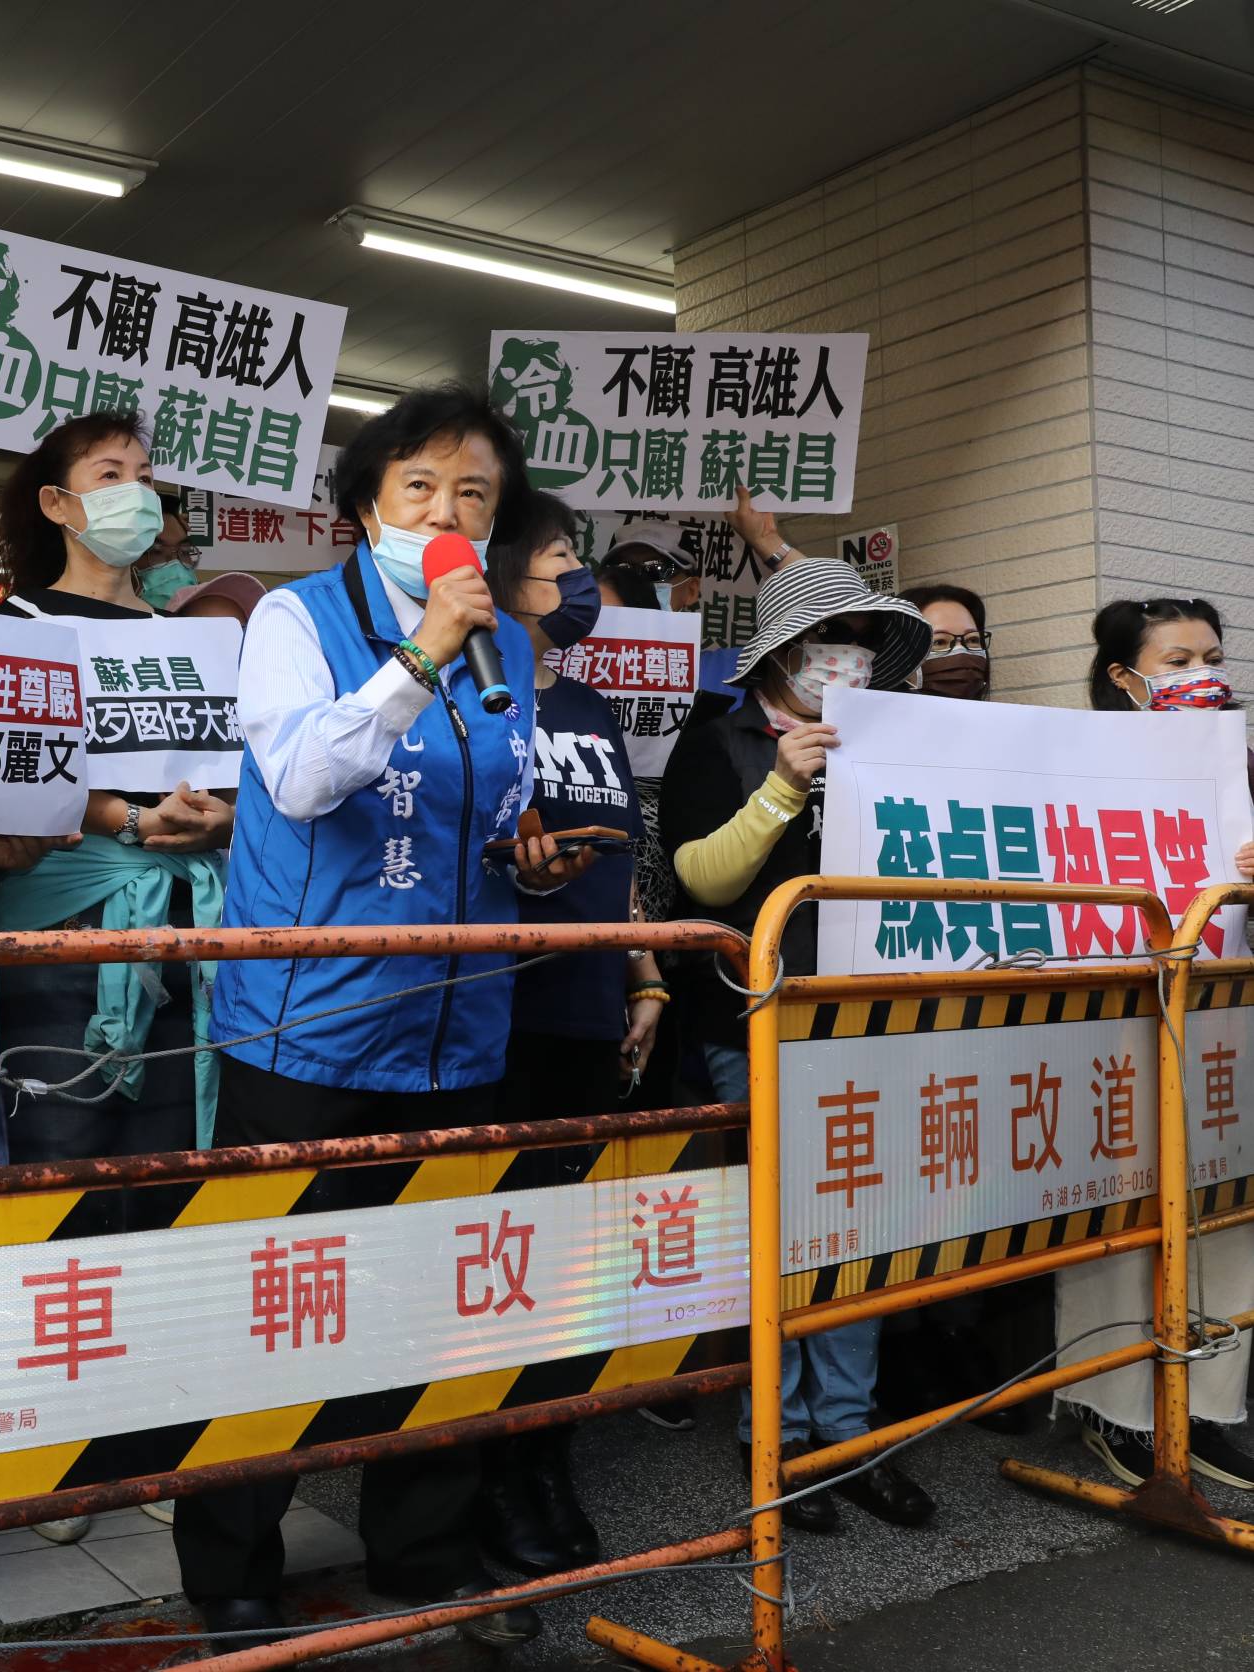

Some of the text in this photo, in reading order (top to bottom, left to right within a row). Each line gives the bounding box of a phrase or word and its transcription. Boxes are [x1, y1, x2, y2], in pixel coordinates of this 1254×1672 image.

[53, 264, 314, 400] 不顧 高雄人
[602, 344, 845, 420] 不顧 高雄人
[149, 385, 303, 492] 蘇貞昌
[596, 429, 837, 503] 只顧 蘇貞昌
[217, 507, 285, 544] 道歉
[90, 656, 206, 693] 蘇貞昌
[533, 726, 623, 790] MT
[543, 780, 629, 809] IN TOGETHER
[1200, 1041, 1240, 1142] 車
[815, 1053, 1140, 1210] 車輛改道
[17, 1184, 704, 1382] 車輛改道
[787, 1227, 859, 1266] 北市警局
[664, 1296, 739, 1325] 103-227
